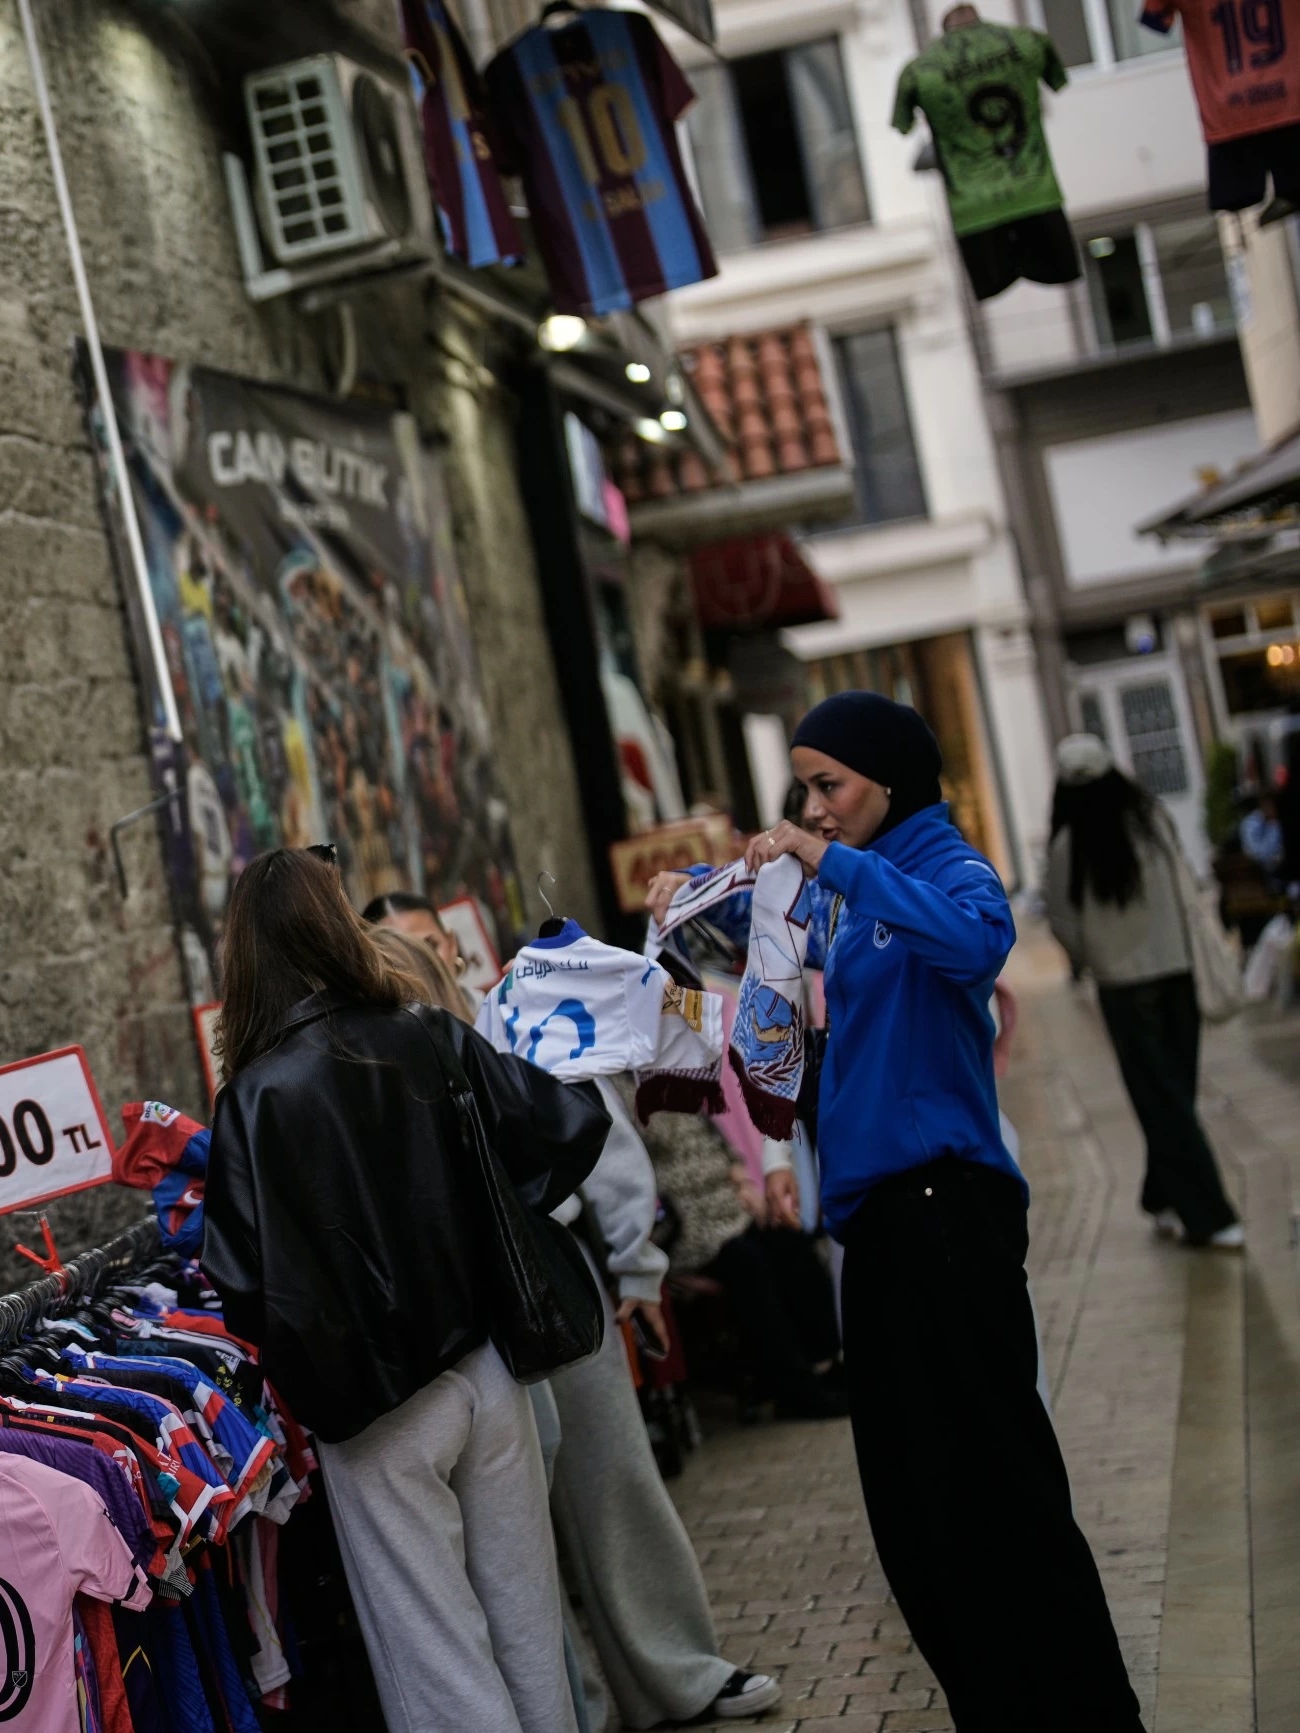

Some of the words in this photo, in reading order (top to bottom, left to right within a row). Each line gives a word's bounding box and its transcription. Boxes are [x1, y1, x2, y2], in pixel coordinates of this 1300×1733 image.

[557, 83, 646, 186] 10
[967, 83, 1027, 157] 9
[62, 1123, 102, 1154] TL
